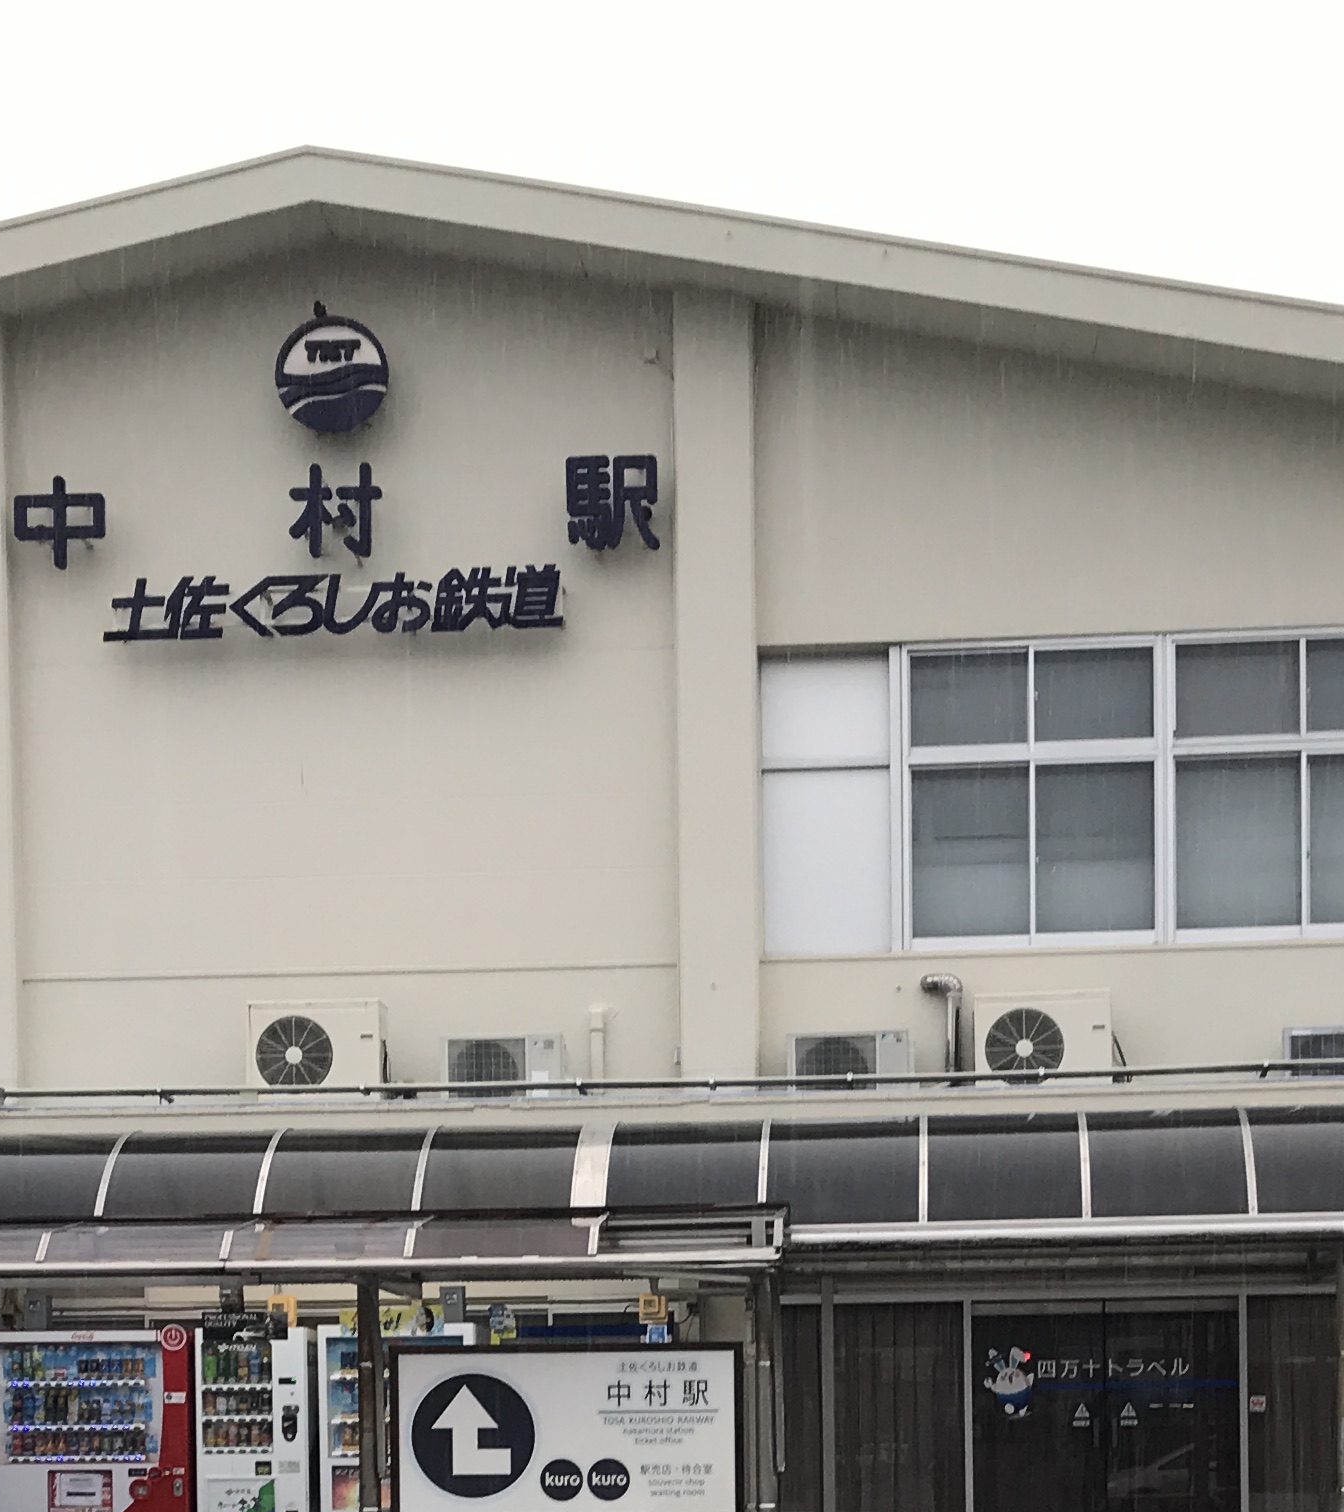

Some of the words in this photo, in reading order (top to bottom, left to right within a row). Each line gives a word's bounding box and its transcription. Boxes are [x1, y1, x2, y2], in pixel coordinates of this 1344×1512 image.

[14, 455, 660, 571] 中村駅
[103, 564, 565, 642] 土佐くろしお鉄道
[1037, 1357, 1191, 1380] 四万十トラベル
[607, 1379, 710, 1408] 中村駅
[545, 1472, 581, 1488] kuro
[591, 1471, 627, 1487] kuro
